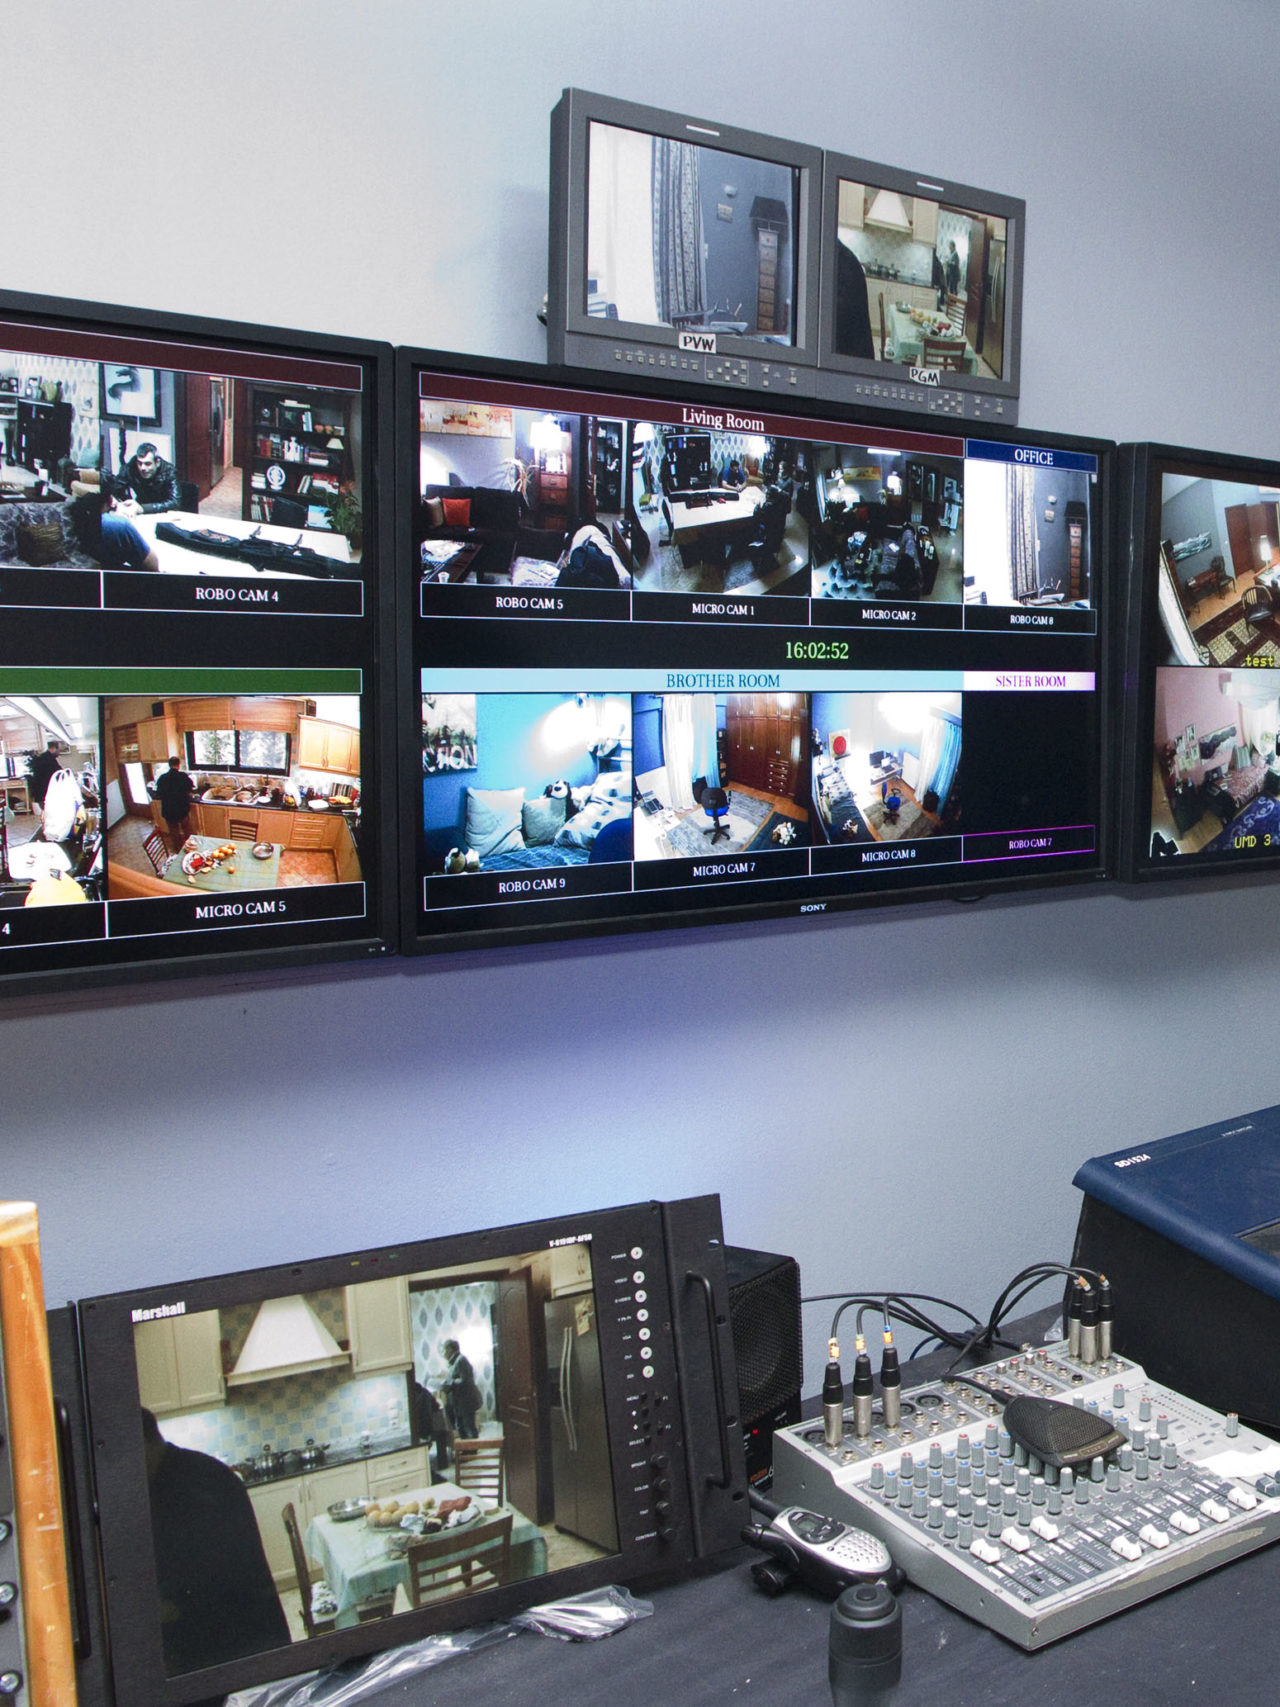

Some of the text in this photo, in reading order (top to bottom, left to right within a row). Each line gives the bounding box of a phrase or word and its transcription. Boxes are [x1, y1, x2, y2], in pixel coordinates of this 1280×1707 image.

[683, 335, 715, 352] PVW
[910, 368, 939, 384] PGM
[682, 407, 765, 432] Living Room
[1014, 448, 1054, 465] OFFICE
[195, 587, 279, 602] ROBO CAM 4
[495, 596, 564, 610] ROBO CAM 5
[691, 602, 755, 616] MICRO CAM 1
[861, 608, 917, 621] MICRO CAM 2
[1010, 614, 1054, 626] ROBO CAM 8
[786, 641, 849, 660] 16:02:52
[1245, 655, 1274, 668] test
[666, 673, 780, 688] BROTHER ROOM
[994, 674, 1066, 688] SISTER ROOM
[1008, 837, 1053, 850] ROBO CAM 7
[1234, 834, 1272, 849] UMD 3
[861, 849, 916, 863] MICRO CAM 8
[693, 862, 756, 878] MICRO CAM 7
[498, 877, 566, 894] ROBO CAM 9
[195, 900, 286, 919] MICRO CAM 5
[800, 903, 827, 913] SONY
[2, 923, 10, 935] 4
[131, 1301, 186, 1323] Marshall
